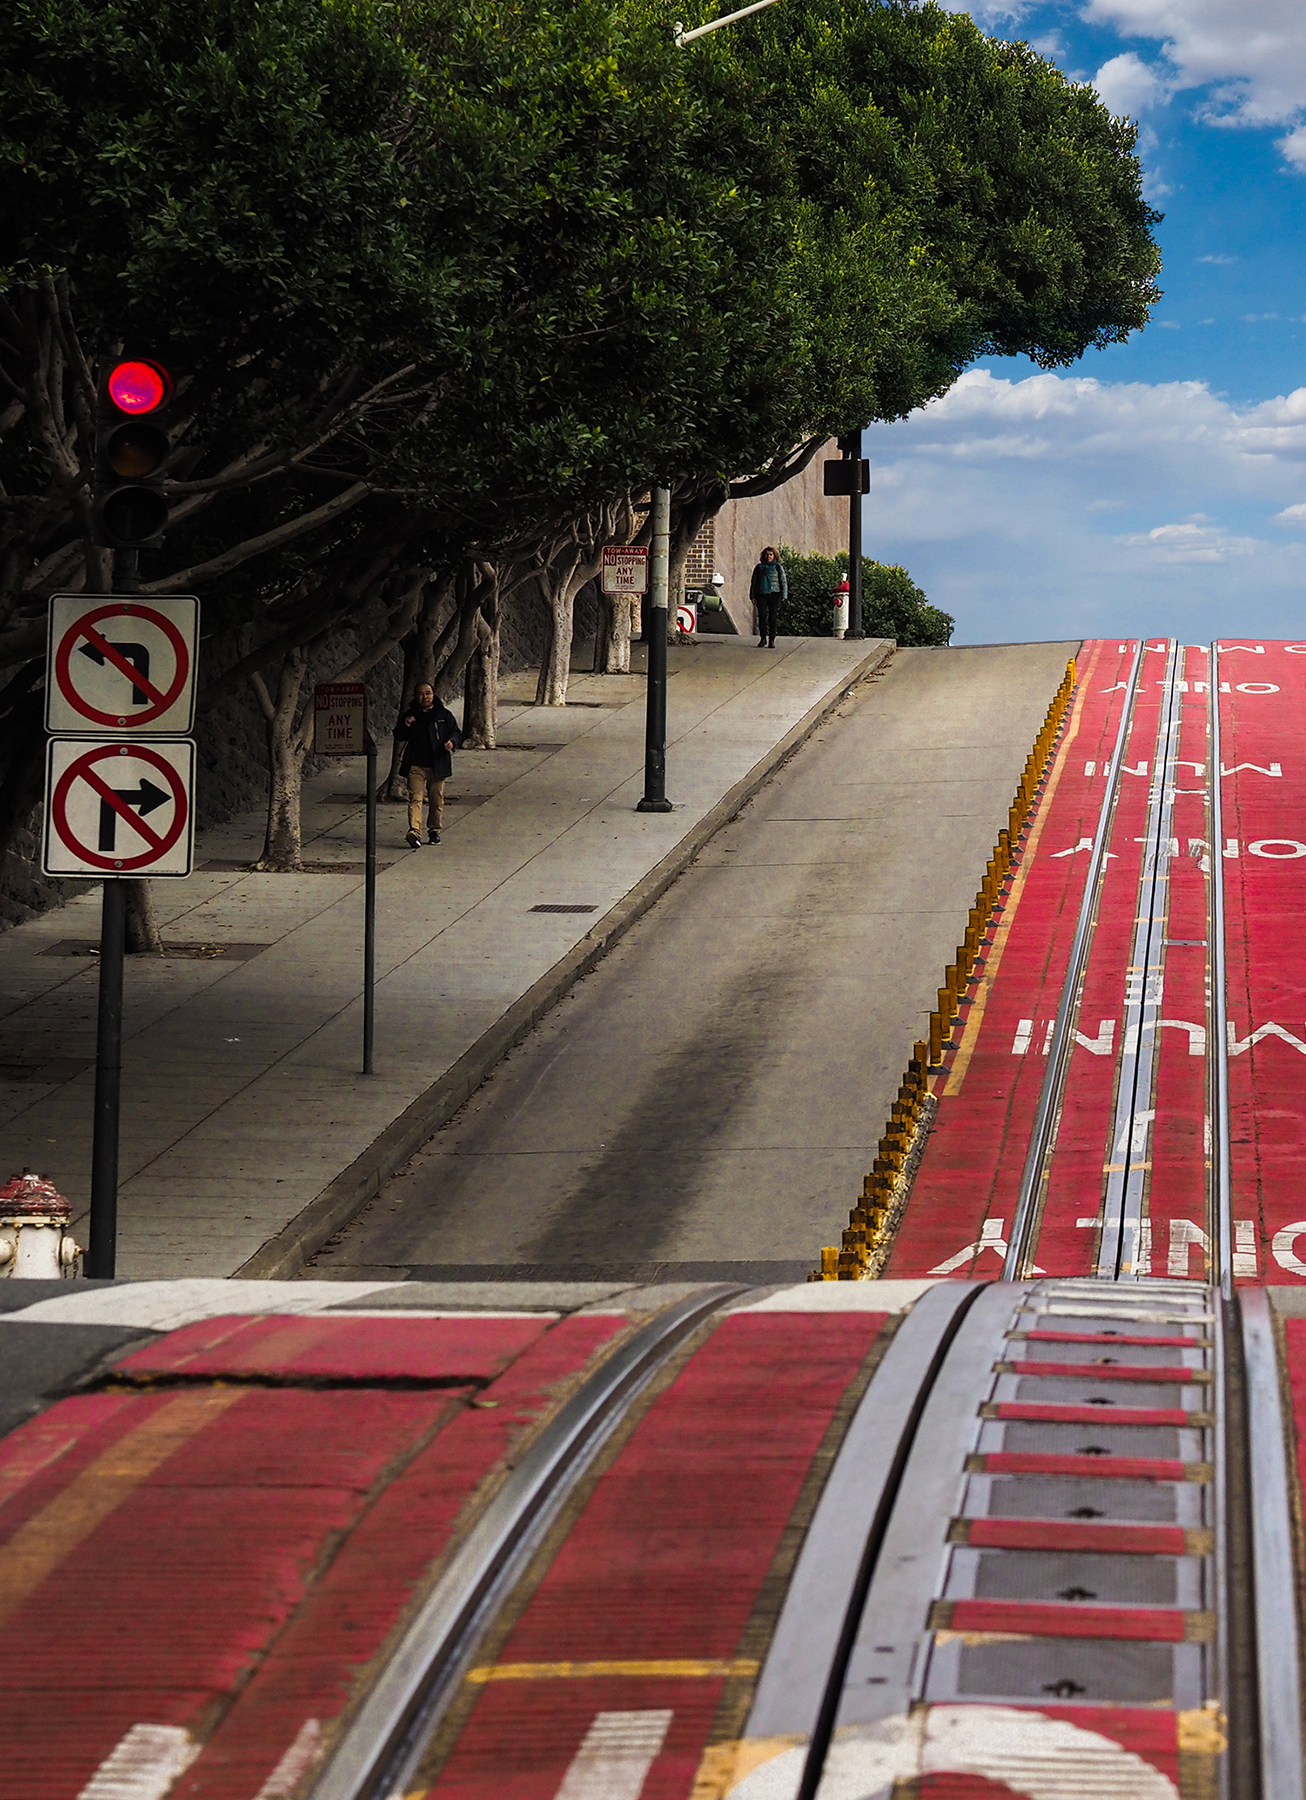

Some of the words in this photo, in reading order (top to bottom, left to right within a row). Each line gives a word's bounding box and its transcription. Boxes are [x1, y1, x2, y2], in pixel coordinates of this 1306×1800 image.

[607, 547, 644, 555] TOW-AWAY
[604, 554, 616, 565] NO
[617, 556, 645, 566] STOPPING
[616, 567, 634, 575] ANY
[615, 576, 635, 585] TIME
[315, 694, 330, 709] NO
[330, 697, 363, 708] STOPPING
[328, 714, 352, 726] ANY
[326, 727, 353, 739] TIME
[1084, 760, 1282, 777] MUNI
